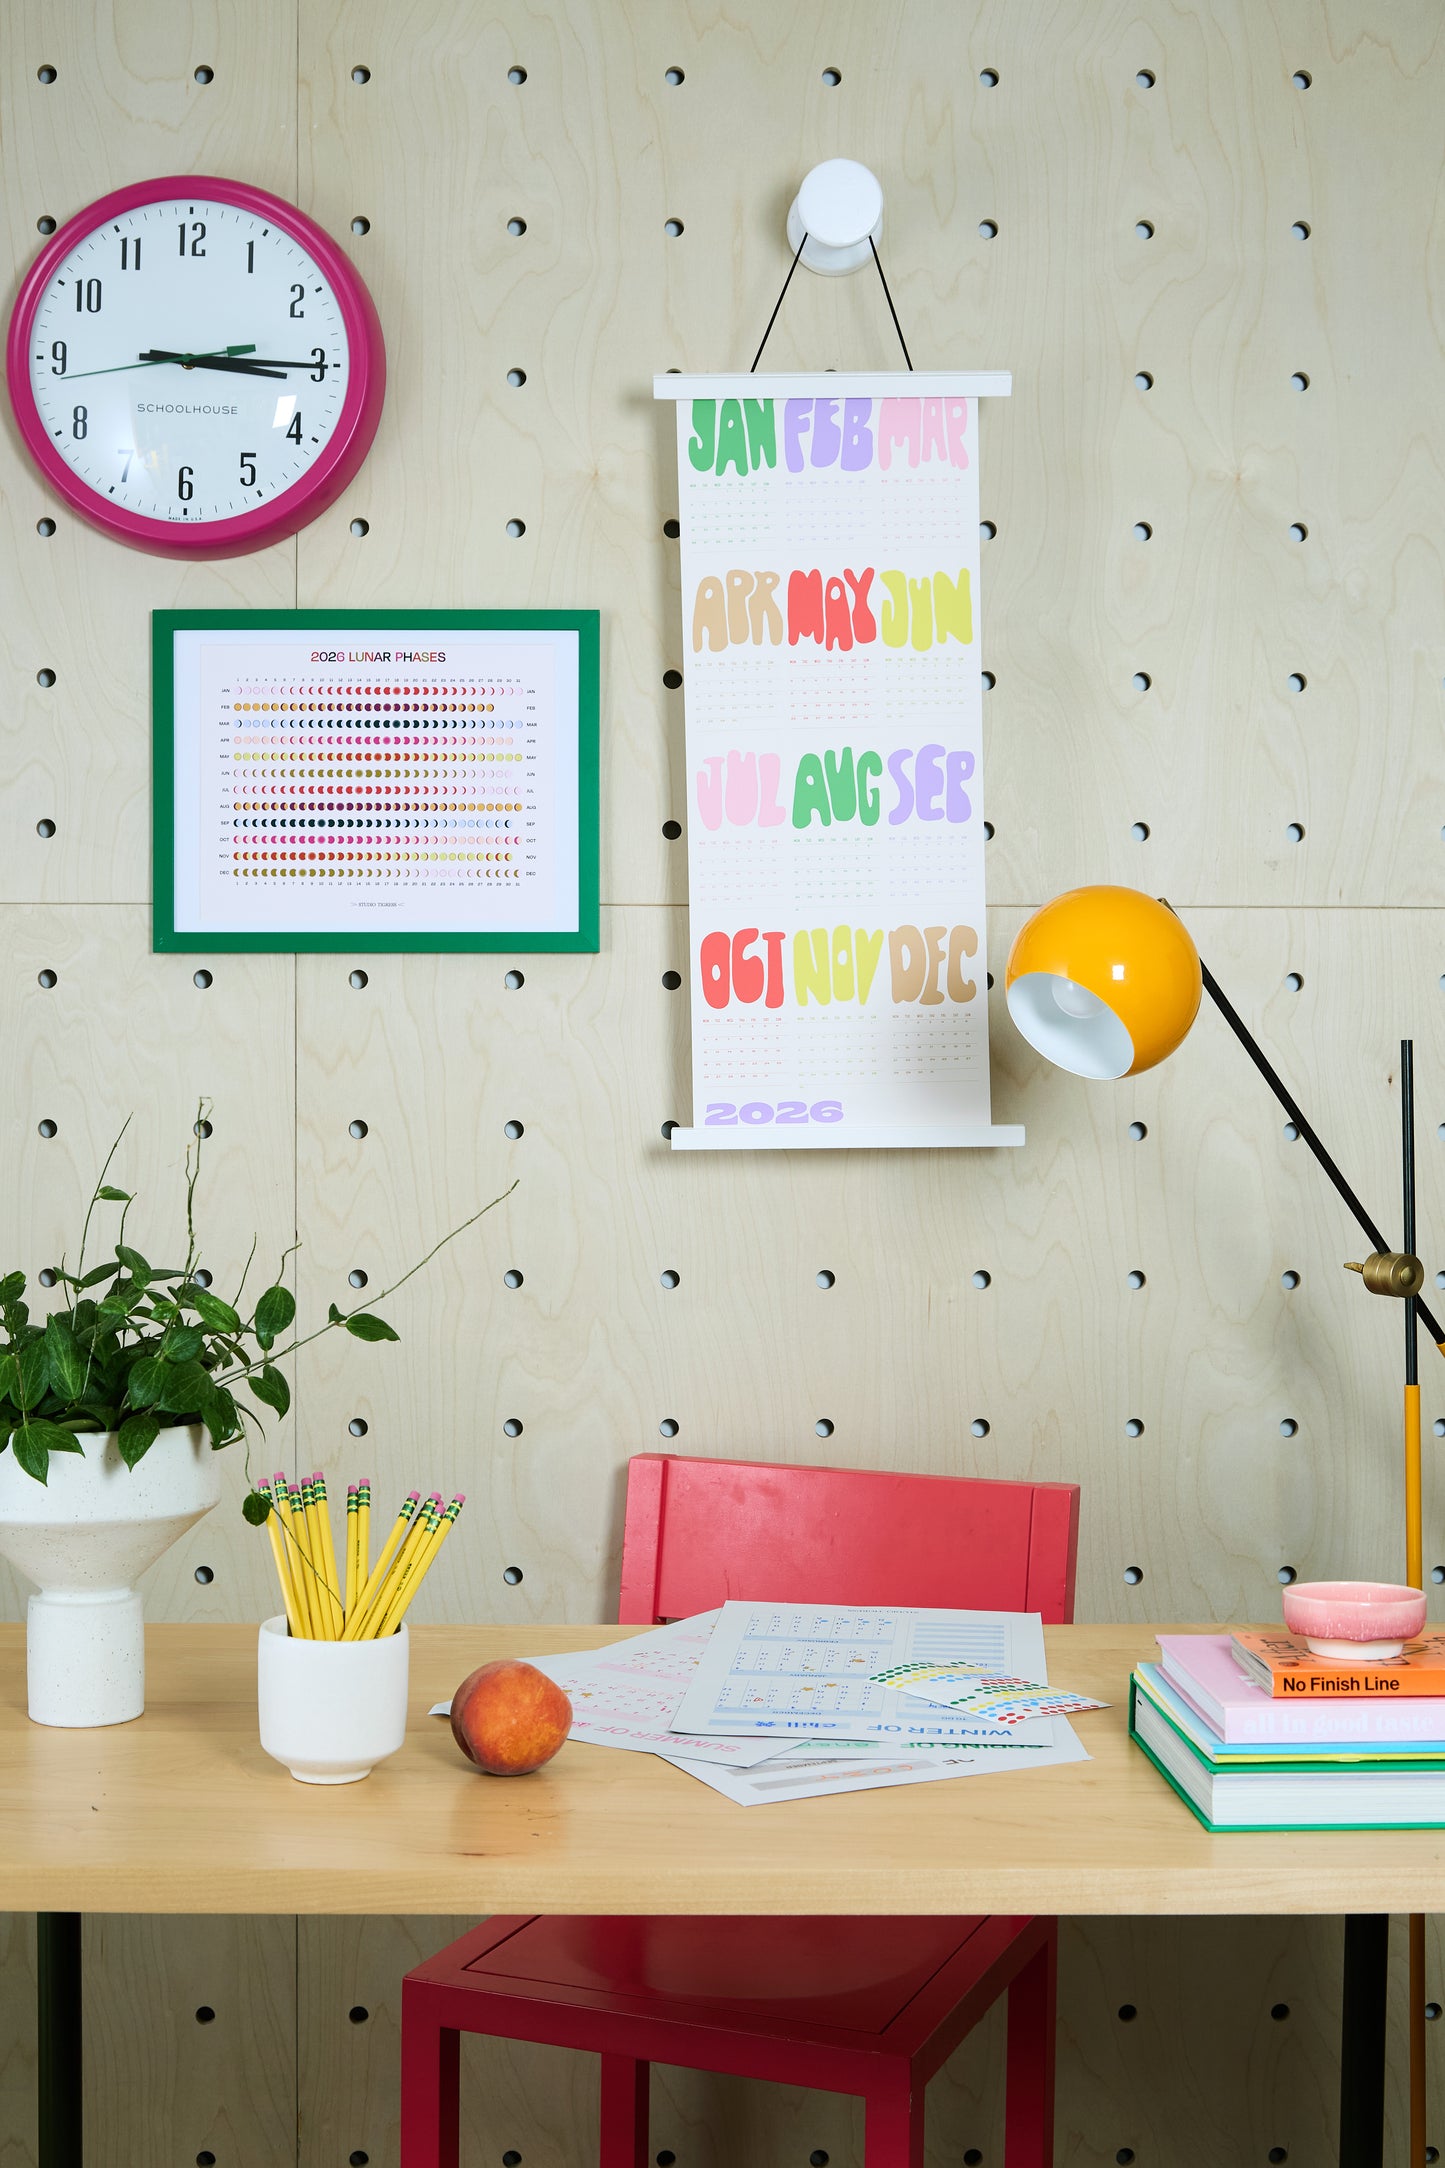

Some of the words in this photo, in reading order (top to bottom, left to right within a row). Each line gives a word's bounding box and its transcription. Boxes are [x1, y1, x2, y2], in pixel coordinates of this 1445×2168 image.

[120, 237, 141, 271] 11
[178, 222, 206, 256] 12
[246, 240, 254, 273] 1
[75, 278, 102, 312] 10
[290, 284, 304, 318] 2
[52, 341, 67, 375] 9
[310, 348, 326, 382] 3
[72, 406, 87, 440] 8
[137, 403, 238, 415] SCHOOLHOUSE
[286, 411, 303, 445] 4
[689, 398, 776, 476] JAN
[784, 398, 873, 473] FEB
[878, 397, 969, 471] MAR
[117, 449, 134, 483] 7
[178, 466, 193, 500] 6
[240, 452, 257, 486] 5
[692, 569, 784, 653] APR
[788, 567, 877, 652] MAY
[880, 568, 973, 652] JUN
[311, 652, 345, 662] 2026
[349, 652, 391, 662] LUNAR
[395, 652, 446, 662] PHASES
[696, 750, 786, 831] JUL
[792, 746, 883, 829] AUG
[887, 744, 975, 825] SEP
[699, 928, 786, 1010] OCT
[793, 924, 884, 1006] NOV
[888, 924, 978, 1005] DEC
[704, 1100, 844, 1126] 2026
[1283, 1678, 1306, 1691] No
[1311, 1677, 1360, 1691] Finish
[1365, 1676, 1400, 1691] Line
[594, 1726, 630, 1735] OF
[630, 1731, 742, 1752] SUMMER
[908, 1727, 1013, 1736] WINTER
[1244, 1713, 1274, 1734] all
[1314, 1713, 1368, 1738] good
